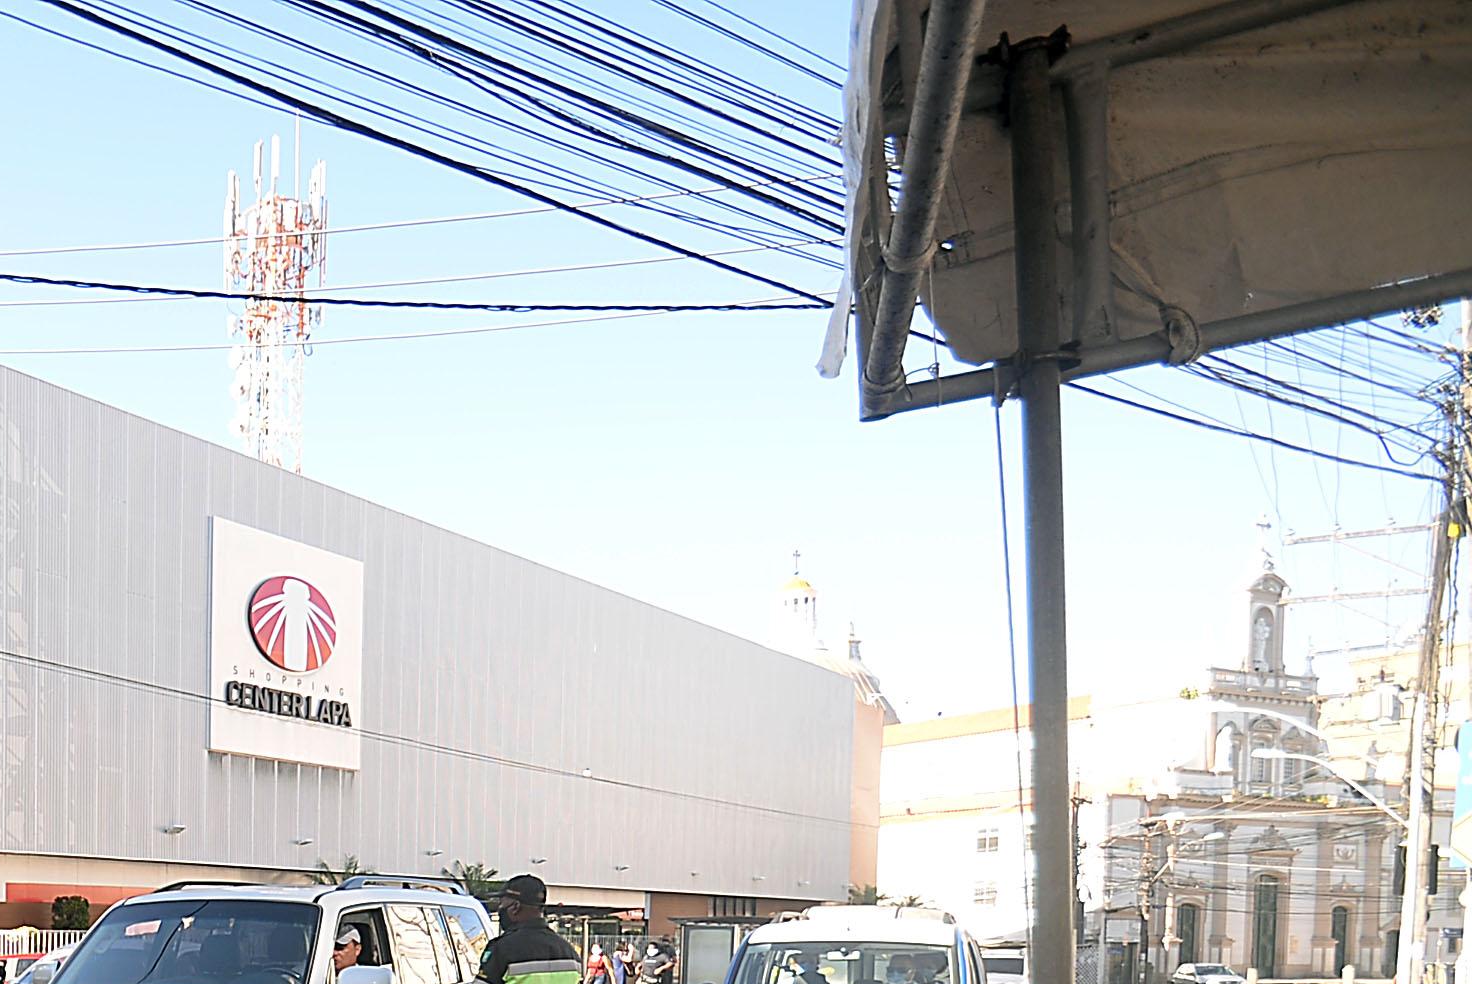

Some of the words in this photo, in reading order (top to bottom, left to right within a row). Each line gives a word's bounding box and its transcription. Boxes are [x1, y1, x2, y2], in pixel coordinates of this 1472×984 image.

[232, 665, 345, 697] SHOPPING
[225, 680, 304, 719] CENTER
[304, 695, 353, 728] LAPA
